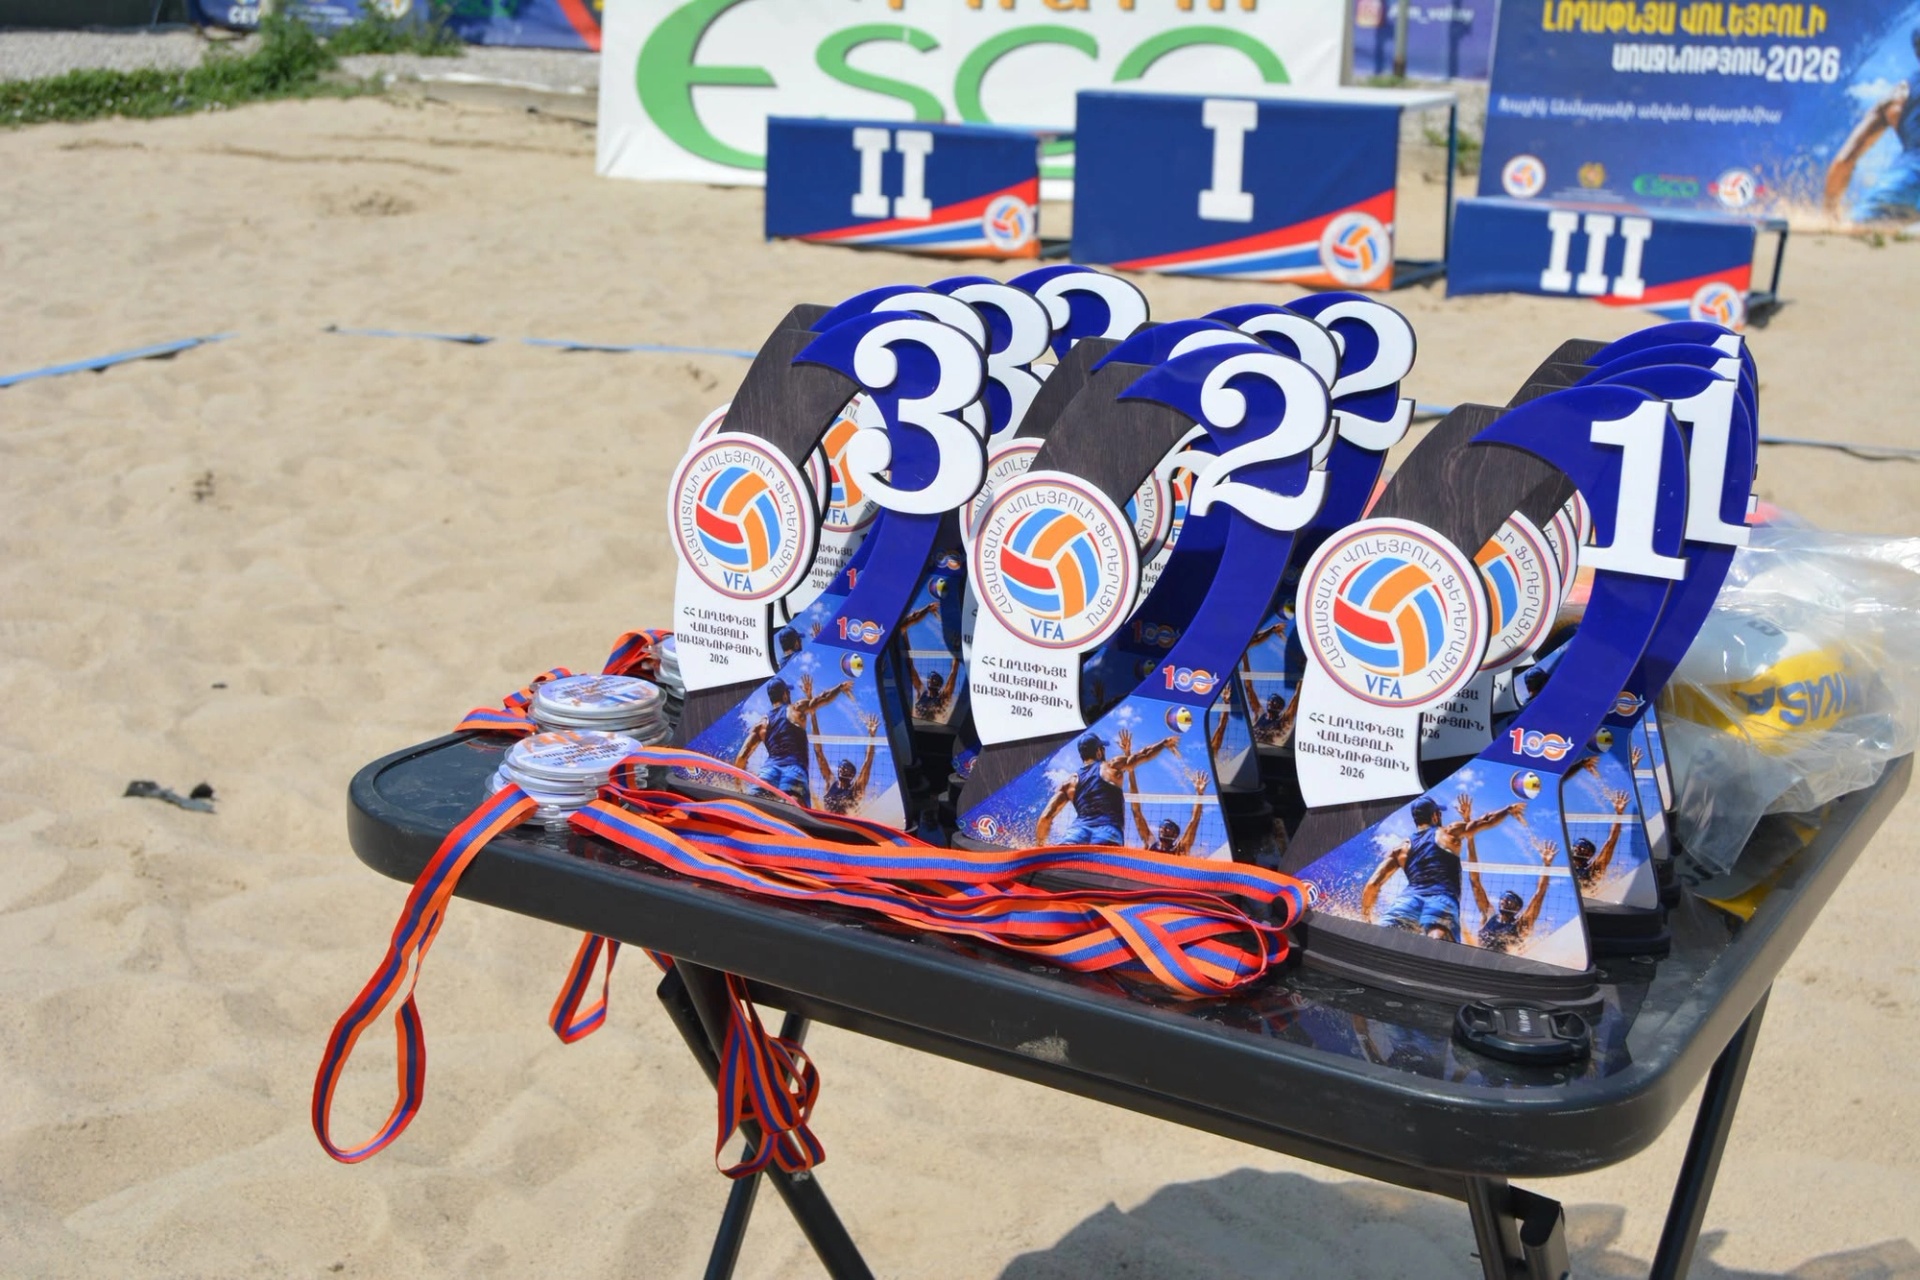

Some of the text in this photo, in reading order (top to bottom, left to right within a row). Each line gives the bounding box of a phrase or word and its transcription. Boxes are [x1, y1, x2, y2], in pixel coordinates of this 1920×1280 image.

[852, 127, 933, 220] II
[1540, 210, 1653, 299] III
[847, 319, 986, 515] 3
[1190, 353, 1328, 531] 2
[1662, 379, 1752, 546] 1
[1577, 400, 1688, 580] 1
[723, 571, 753, 592] VFA
[1315, 564, 1346, 669] ՀԱՅԱՍՏԱՆԻ
[1343, 539, 1442, 572] ՎՈԼԵՅԲՈԼԻ
[1030, 618, 1065, 641] VFA
[709, 653, 729, 665] 2026
[989, 672, 1058, 692] ՎՈԼԵՅԲՈԼԻ
[1365, 674, 1403, 699] VFA
[1010, 704, 1033, 718] 2026
[1733, 673, 1866, 727] IKASA
[1317, 729, 1394, 753] ՎՈԼԵՅԲՈԼԻ
[1421, 728, 1440, 740] 026
[1339, 765, 1365, 780] 2026
